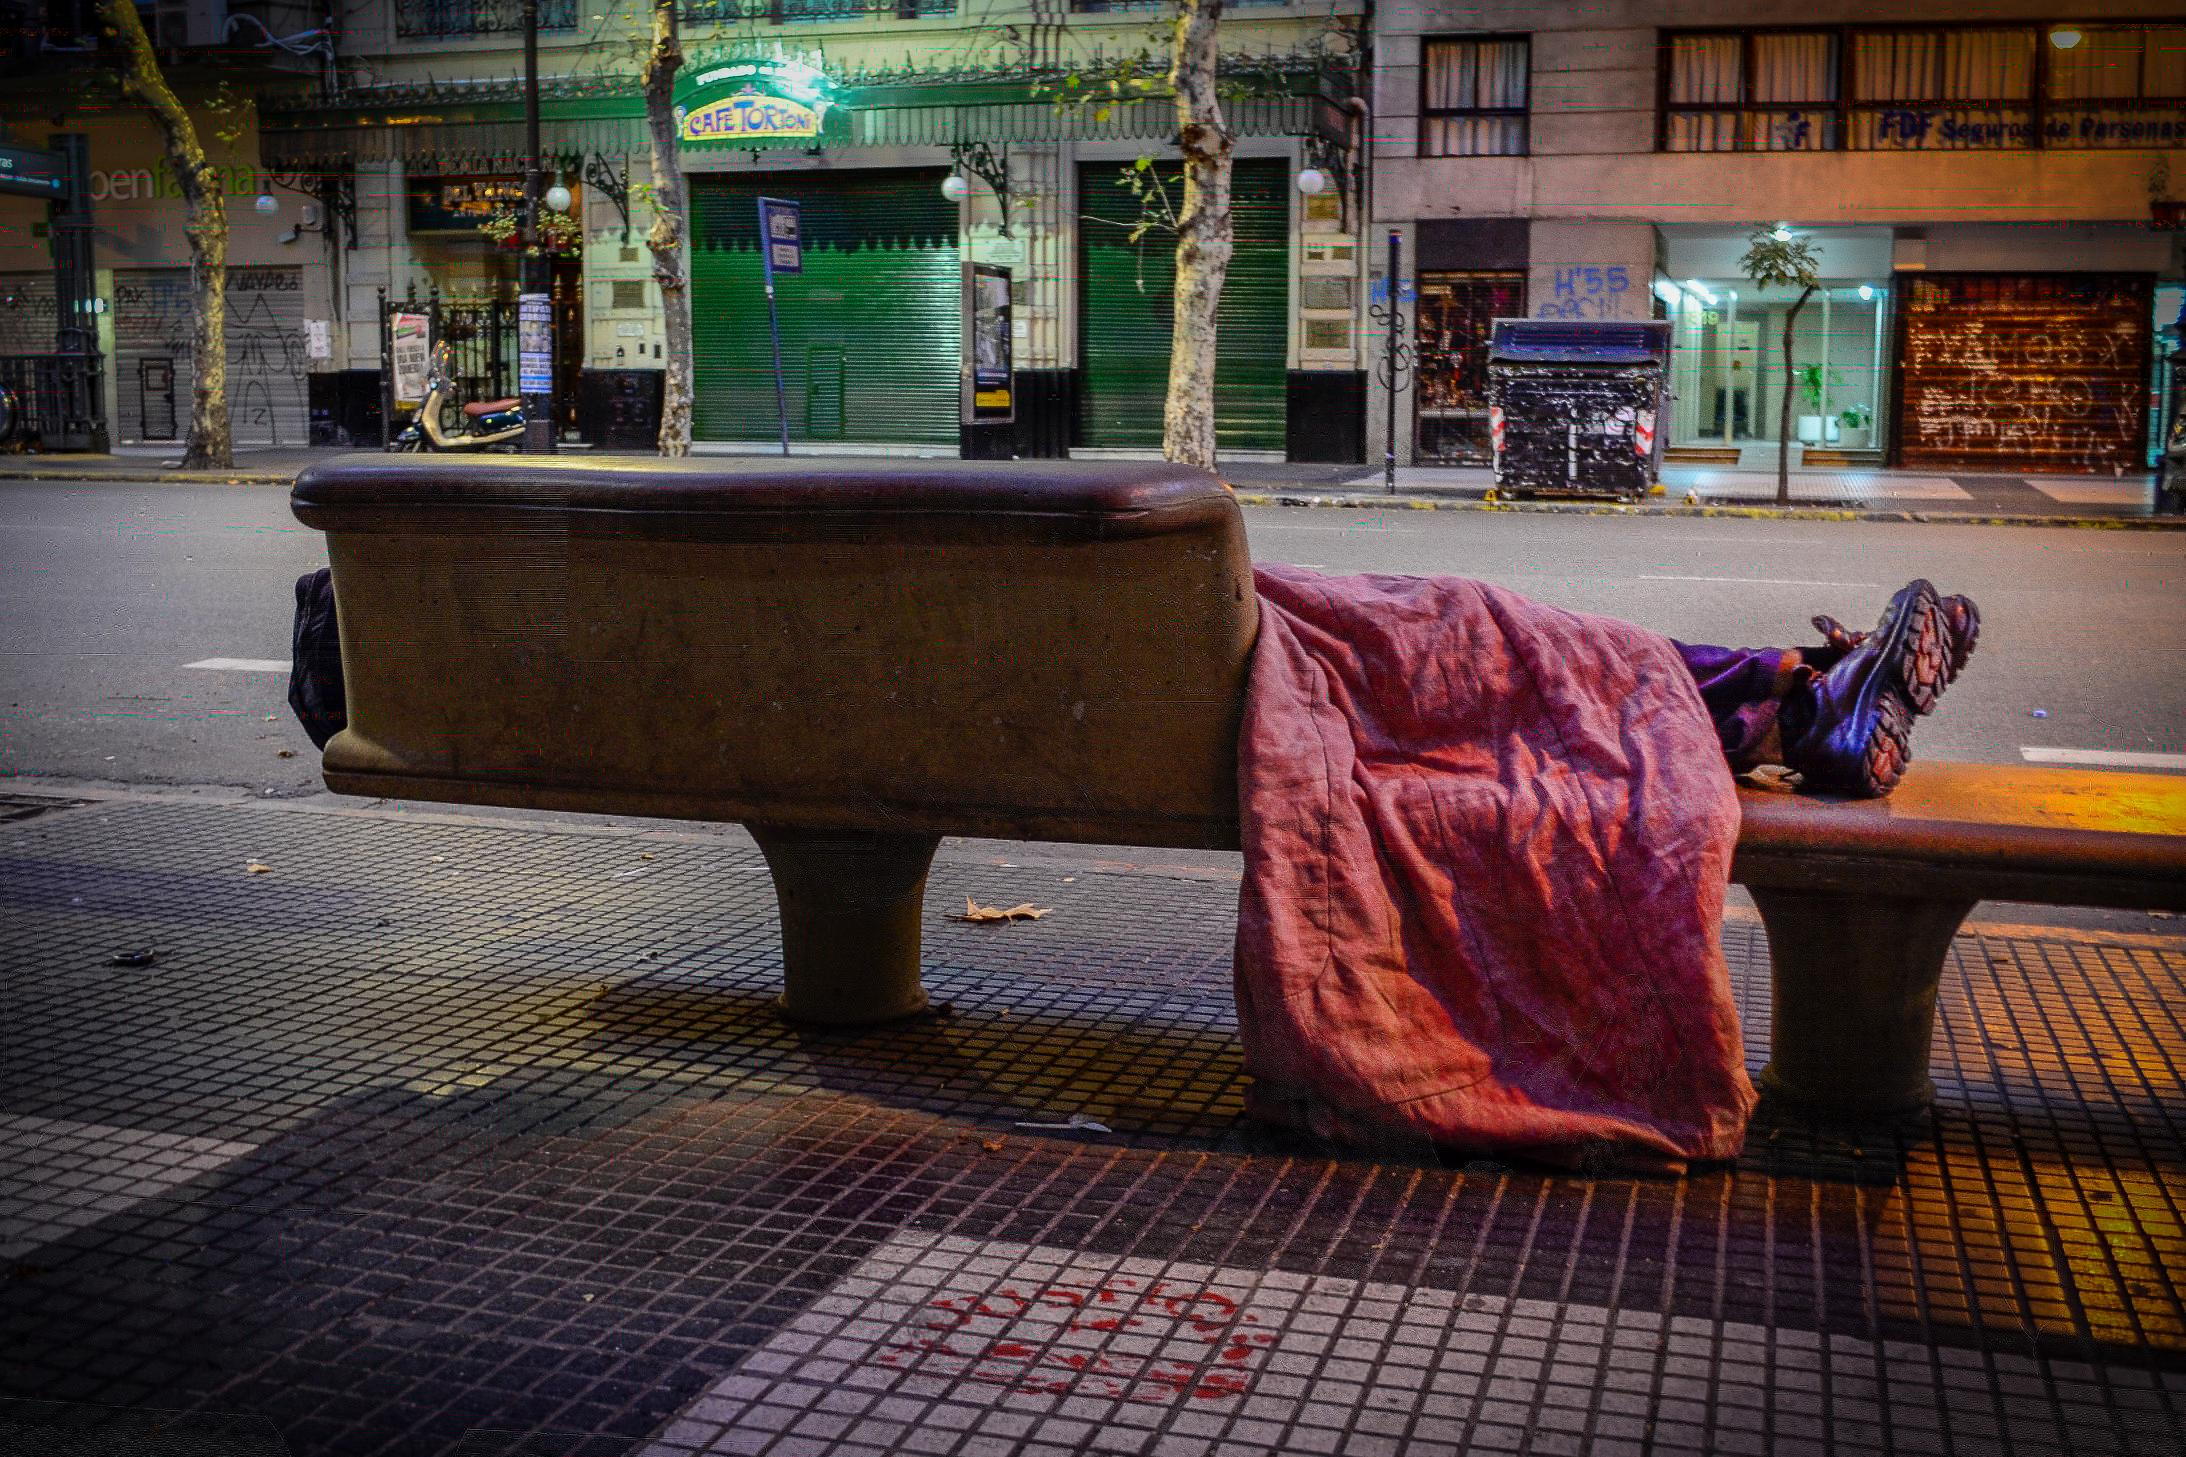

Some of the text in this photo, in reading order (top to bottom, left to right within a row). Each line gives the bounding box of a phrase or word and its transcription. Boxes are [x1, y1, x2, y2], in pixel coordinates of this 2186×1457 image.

[689, 101, 812, 136] CAFE TORTONI
[1880, 110, 1935, 140] FDF
[1940, 117, 2034, 143] Seguros
[2045, 117, 2071, 138] de
